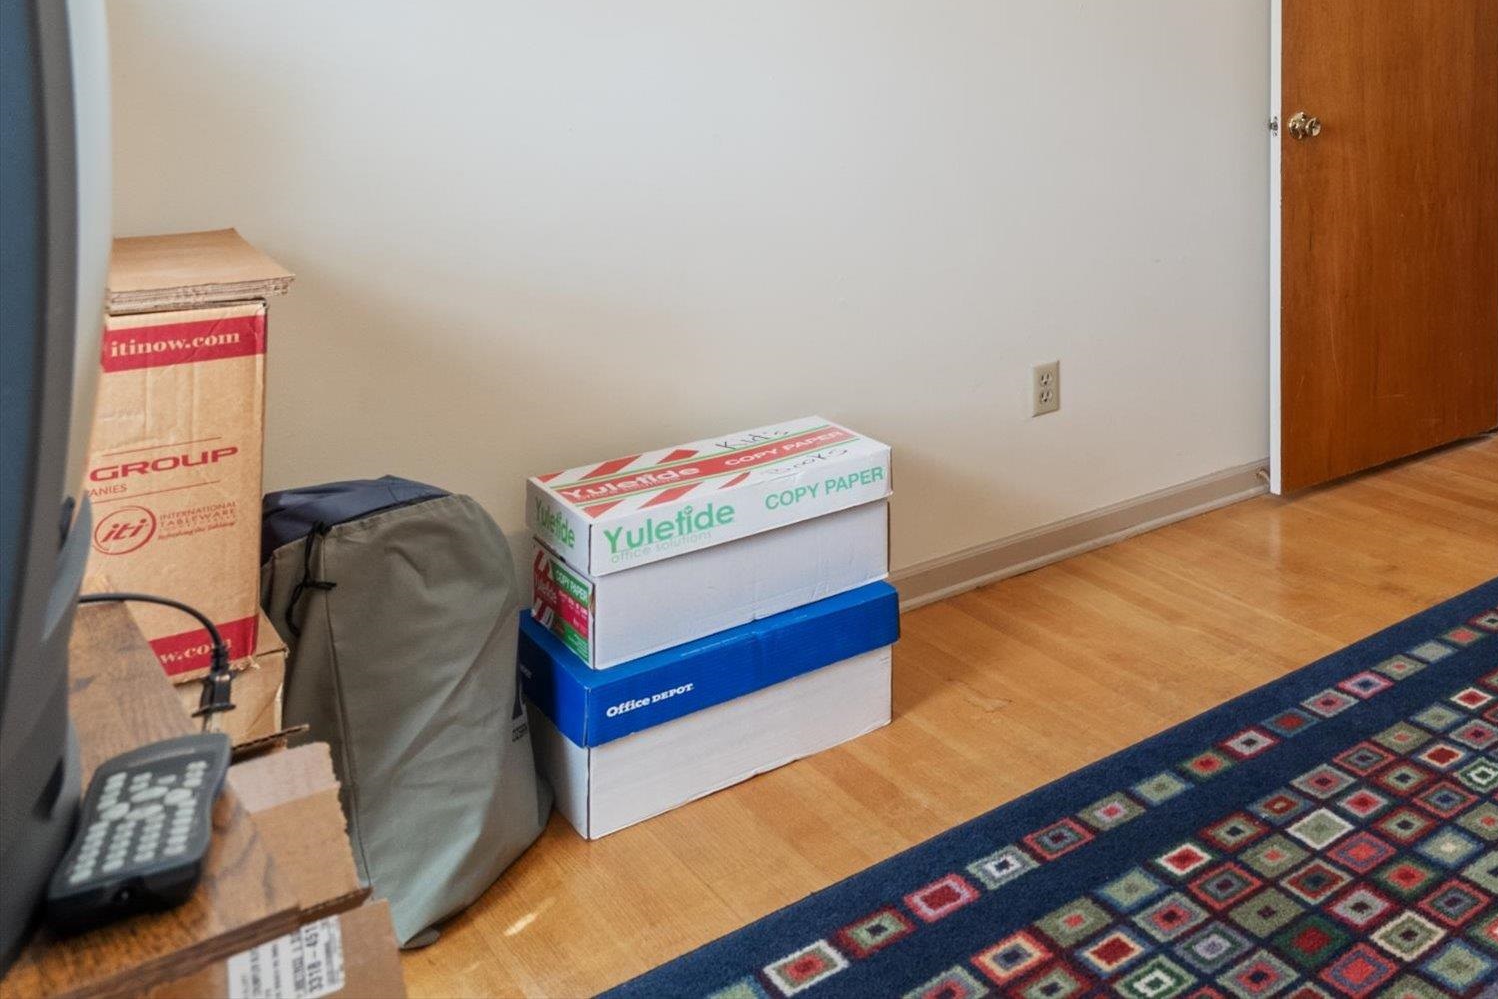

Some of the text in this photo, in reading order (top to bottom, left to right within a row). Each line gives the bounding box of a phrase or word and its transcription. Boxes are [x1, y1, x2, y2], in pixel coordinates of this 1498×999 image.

[111, 332, 240, 357] itinow.com
[90, 446, 239, 482] GROUP
[562, 467, 700, 499] Yuletide
[724, 448, 779, 466] COPY
[783, 430, 845, 451] PAPER
[87, 483, 128, 498] ANIES
[603, 466, 885, 555] Yuletide COPY PAPER
[610, 542, 652, 565] office
[606, 683, 694, 718] Office DEPOT
